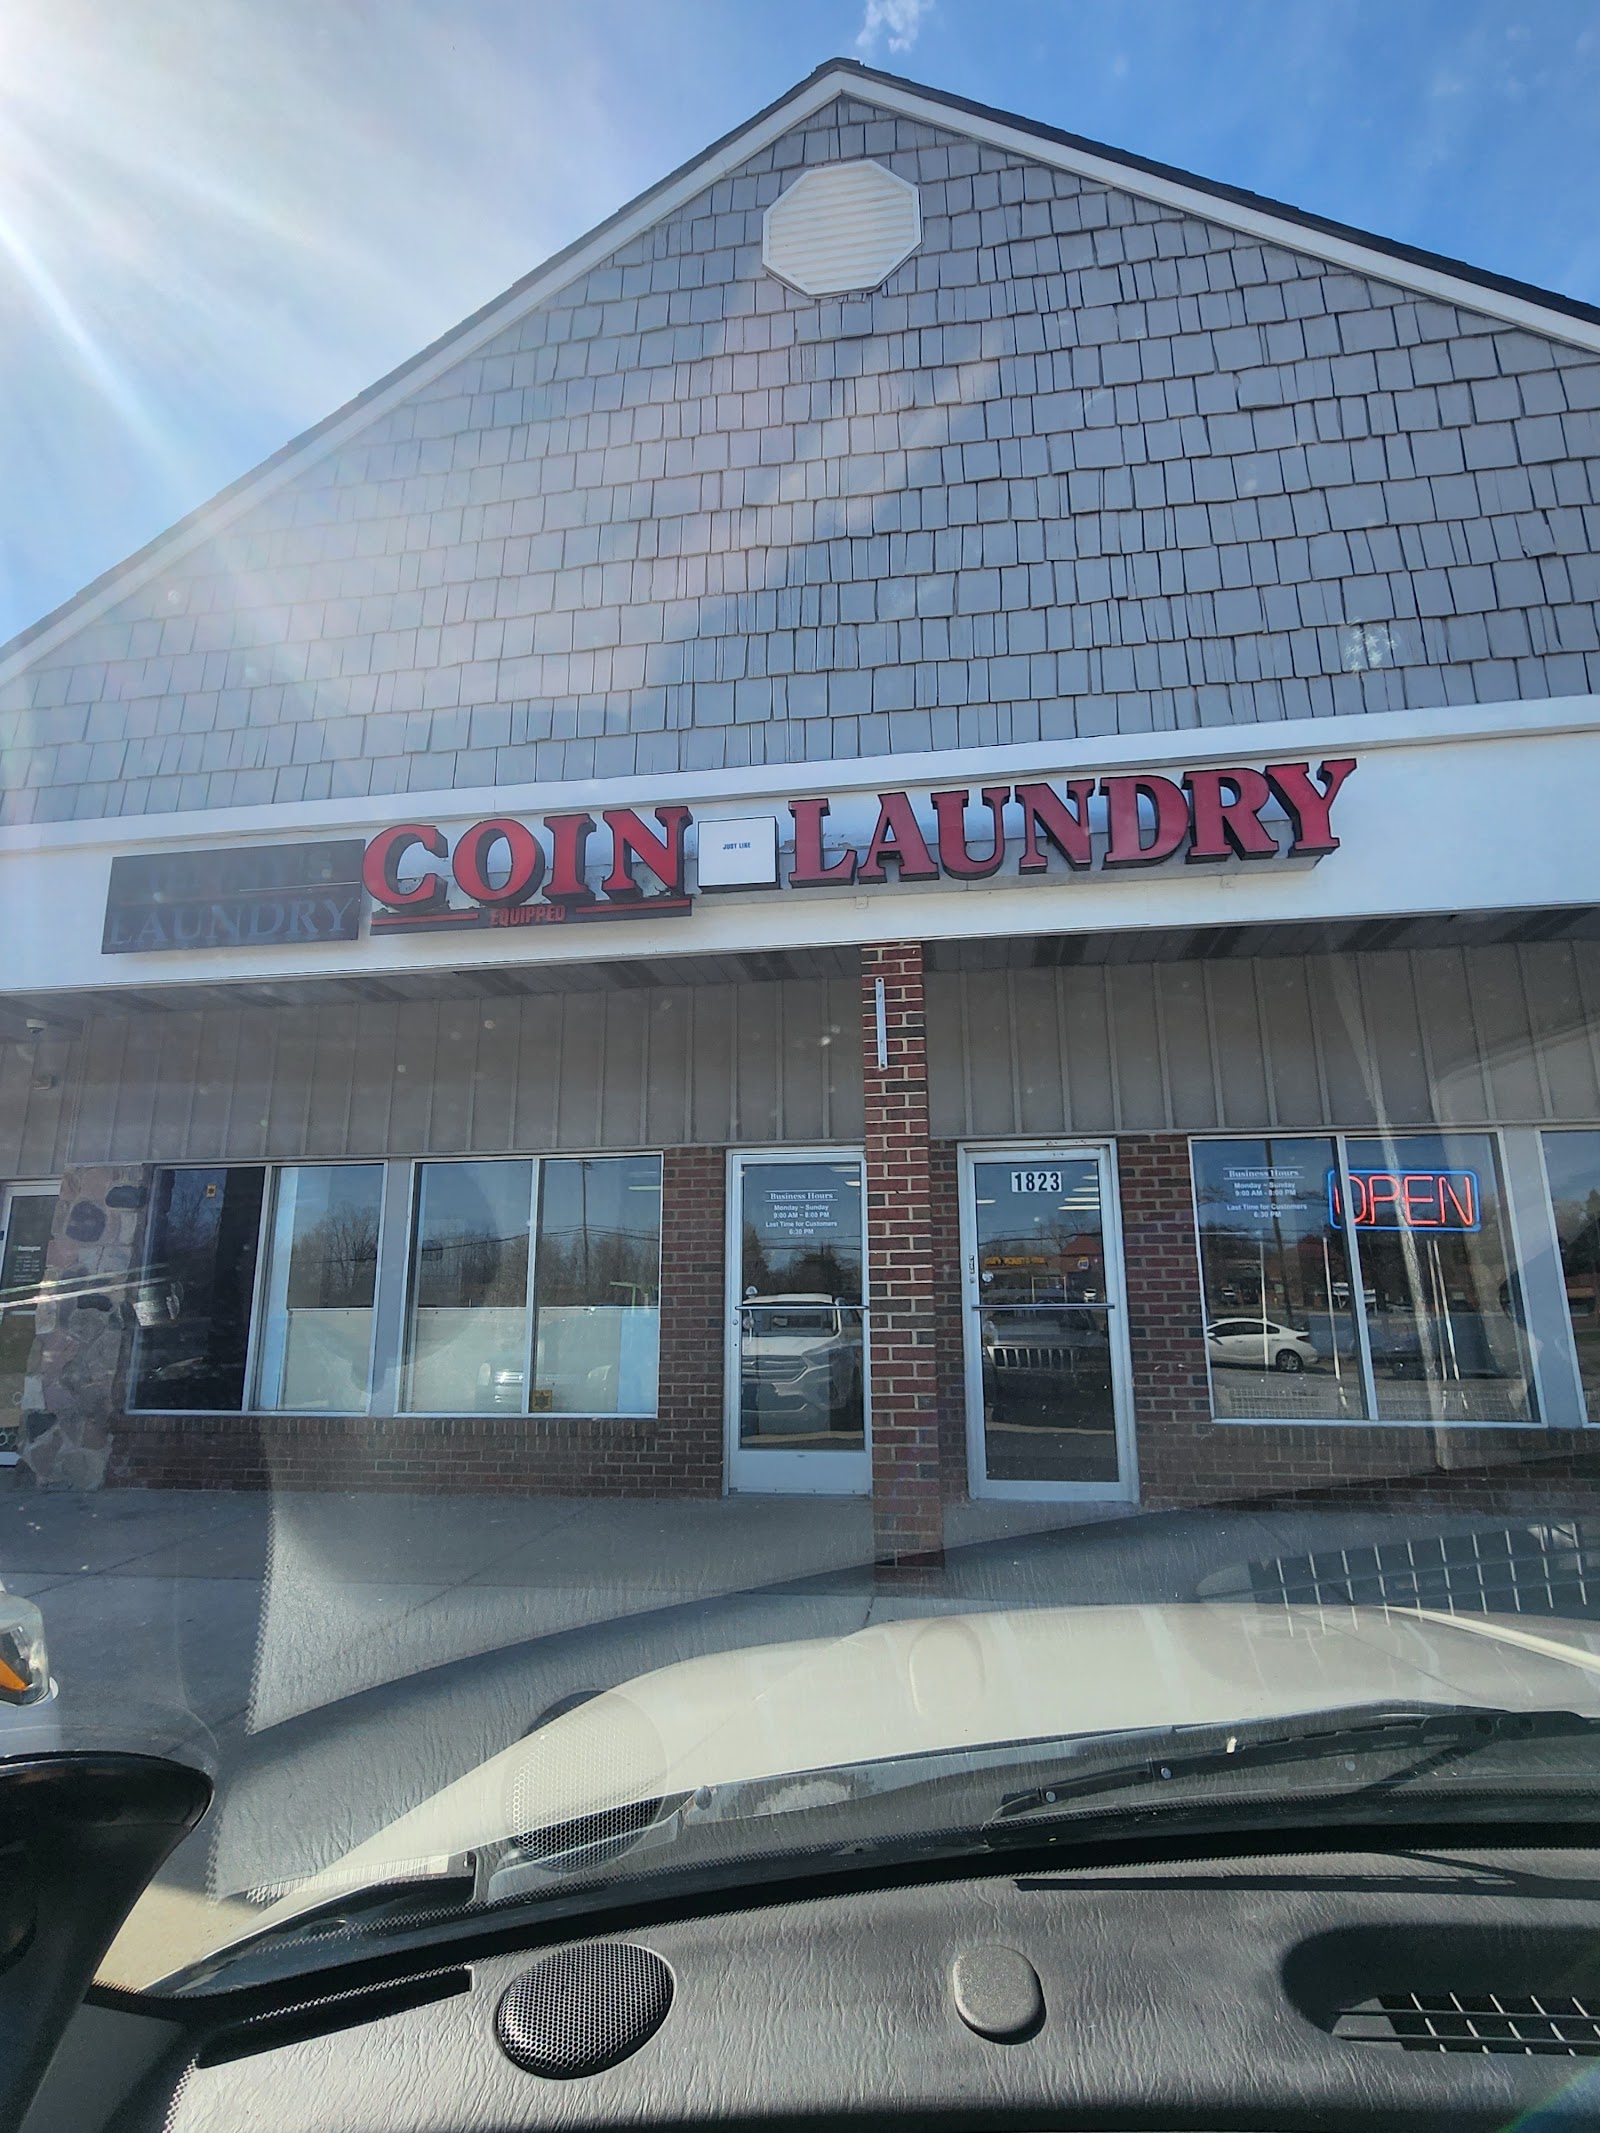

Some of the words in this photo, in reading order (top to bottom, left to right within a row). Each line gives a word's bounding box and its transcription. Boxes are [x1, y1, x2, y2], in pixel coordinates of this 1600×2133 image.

[362, 806, 693, 906] COIN
[788, 758, 1357, 888] LAUNDRY
[108, 898, 354, 946] LAUNDRY
[490, 905, 566, 928] EQUIPPED
[1014, 1172, 1060, 1192] 1823
[1229, 1170, 1268, 1178] Business
[1270, 1168, 1299, 1177] Hours
[770, 1192, 806, 1200] Business
[1234, 1182, 1261, 1190] Monday
[1269, 1182, 1295, 1190] Sunday
[774, 1204, 799, 1212] Monday
[805, 1204, 829, 1212] Sunday
[1334, 1175, 1474, 1226] OPEN
